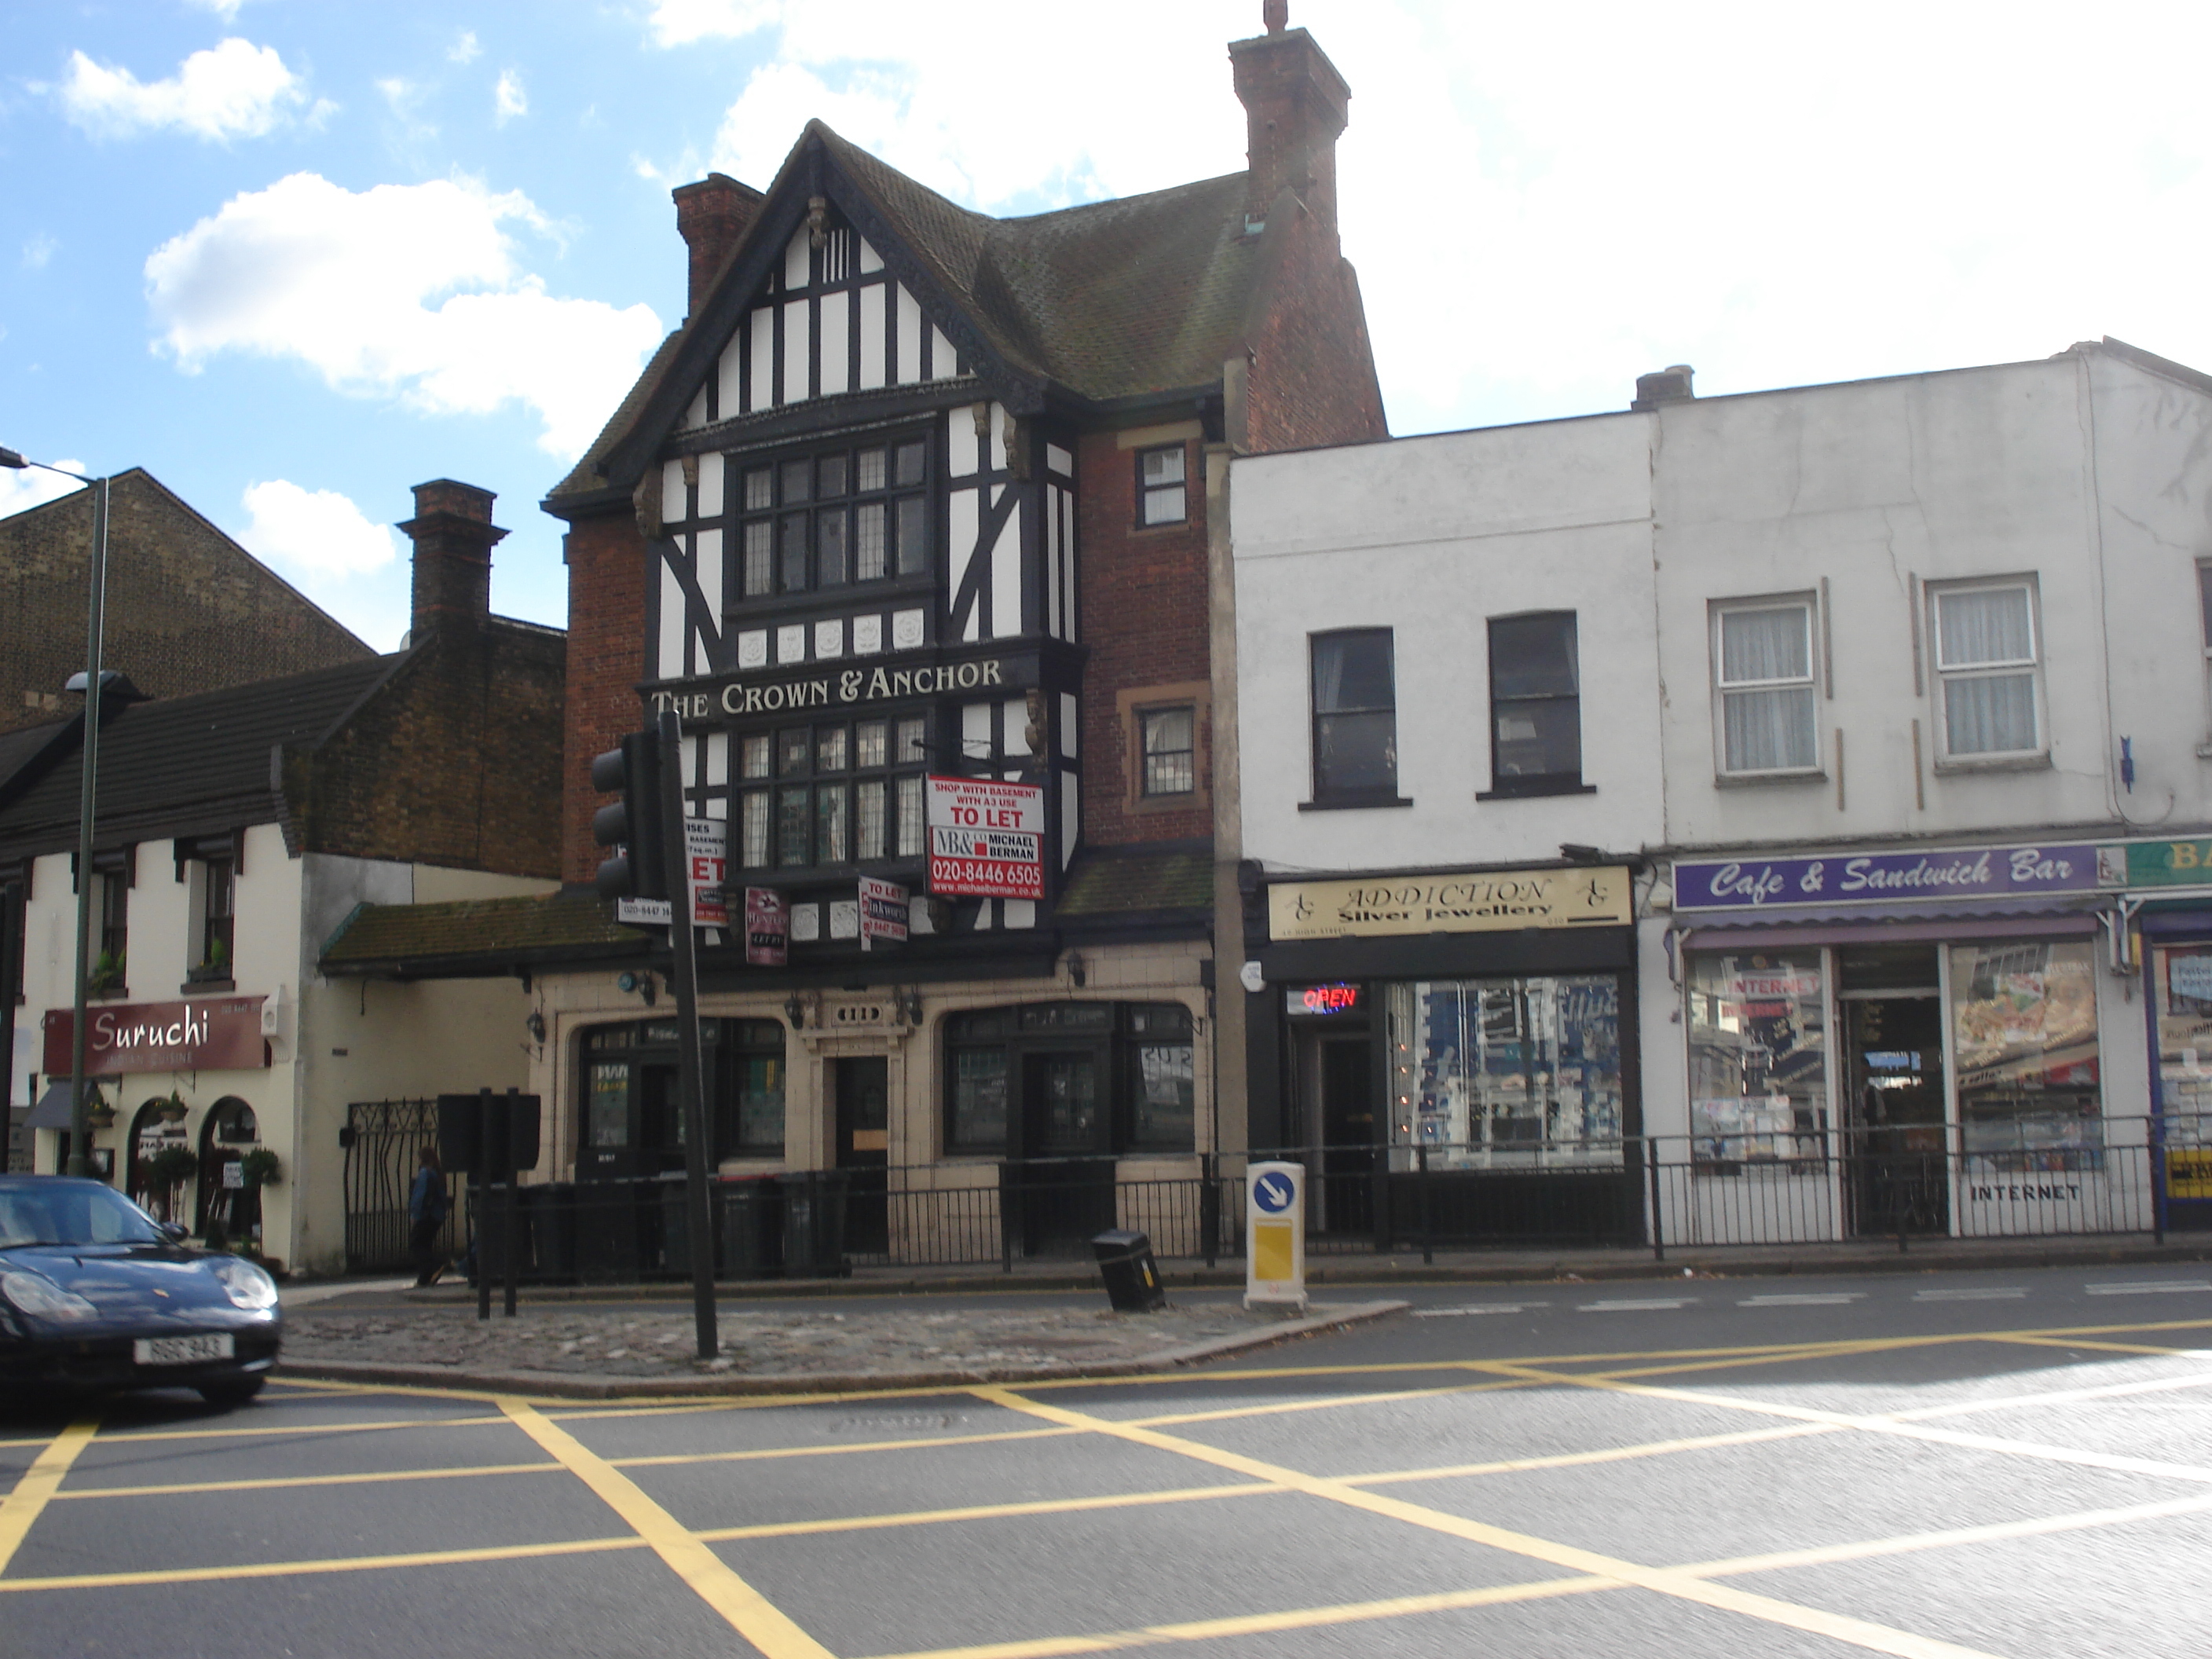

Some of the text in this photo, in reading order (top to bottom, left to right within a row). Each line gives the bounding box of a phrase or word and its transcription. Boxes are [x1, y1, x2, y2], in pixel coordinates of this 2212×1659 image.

[651, 660, 1002, 718] THE CROWN & ANCHOR
[935, 783, 1037, 799] SHOP WITH BASEMENT
[957, 795, 1017, 808] WITH A3 USE
[950, 807, 1024, 828] TO LET
[989, 833, 1035, 848] MICHAEL
[990, 847, 1034, 859] BERMAN
[692, 857, 726, 882] ET
[932, 859, 1041, 885] 020-8446 6505
[1710, 848, 2074, 905] Cafe & Sandwich Bar
[870, 882, 903, 898] TO LET
[933, 882, 1042, 897] www.michaelberman.co.uk
[1338, 878, 1552, 909] ADDICTION
[869, 898, 907, 920] inkworth
[1339, 903, 1552, 924] Silver Jewellery
[1304, 989, 1356, 1007] OPEN
[93, 1004, 208, 1051] Suruchi
[1971, 1185, 2079, 1200] INTERNET
